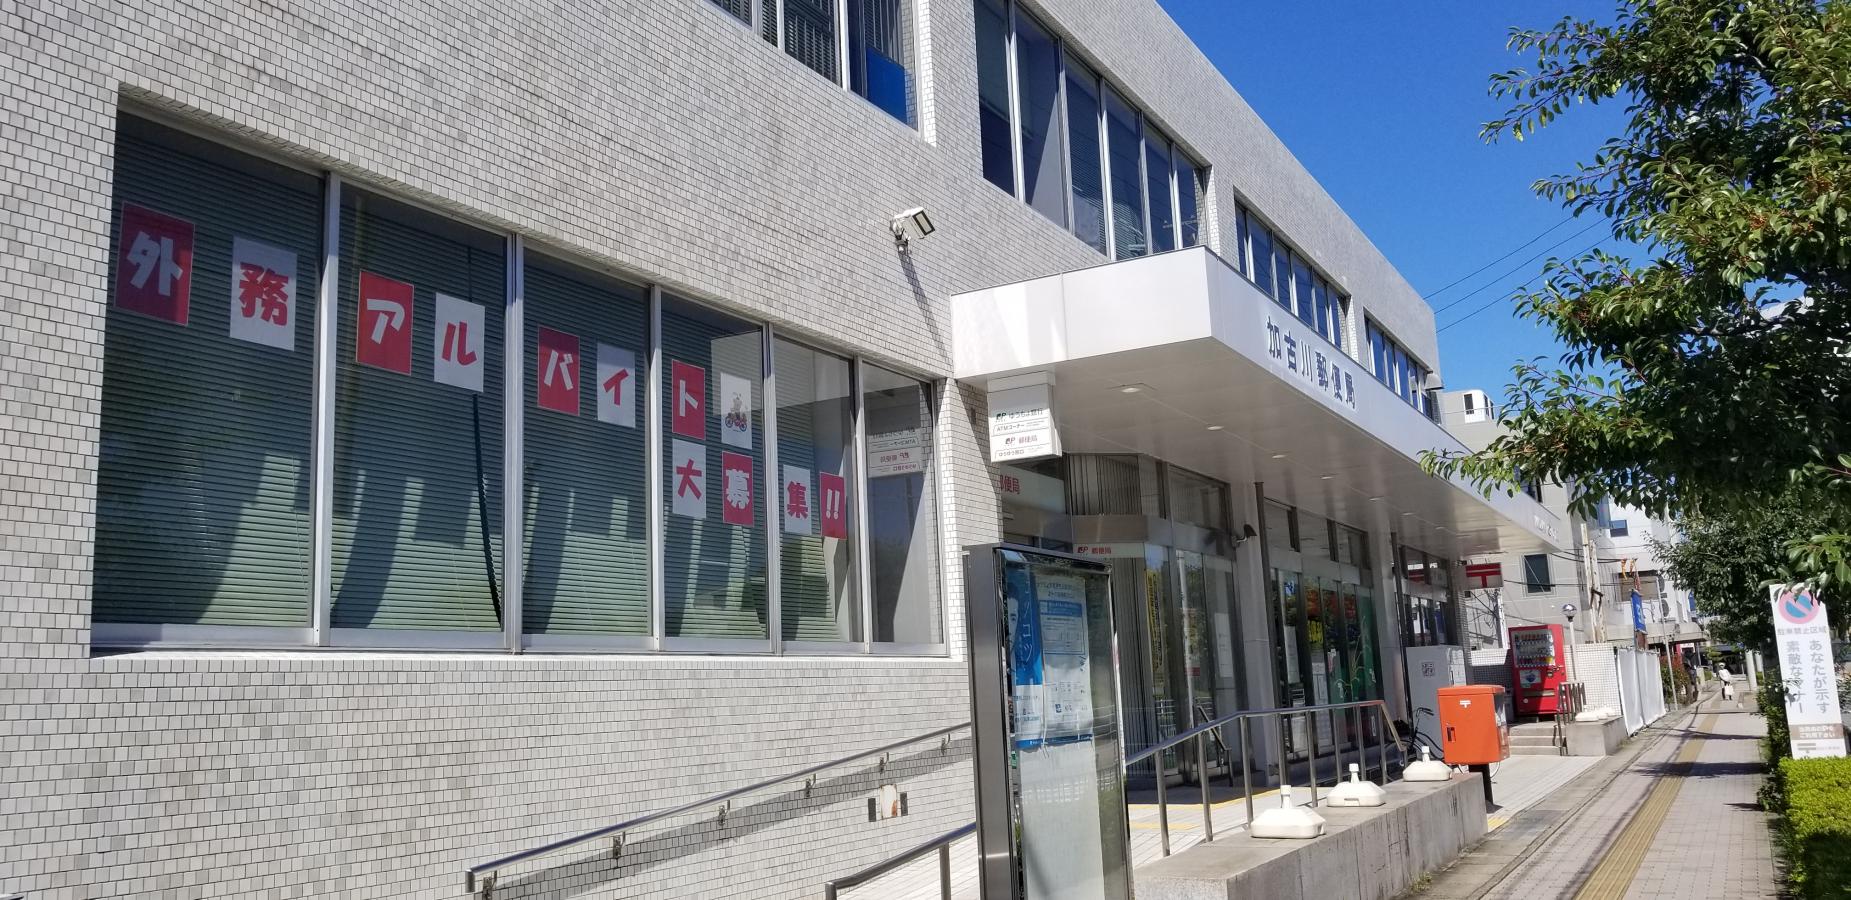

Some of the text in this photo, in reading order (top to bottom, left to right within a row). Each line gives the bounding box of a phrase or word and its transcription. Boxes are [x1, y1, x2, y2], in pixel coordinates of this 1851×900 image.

[1266, 315, 1356, 410] 加古川郵便局
[1809, 639, 1830, 714] あなたが示す
